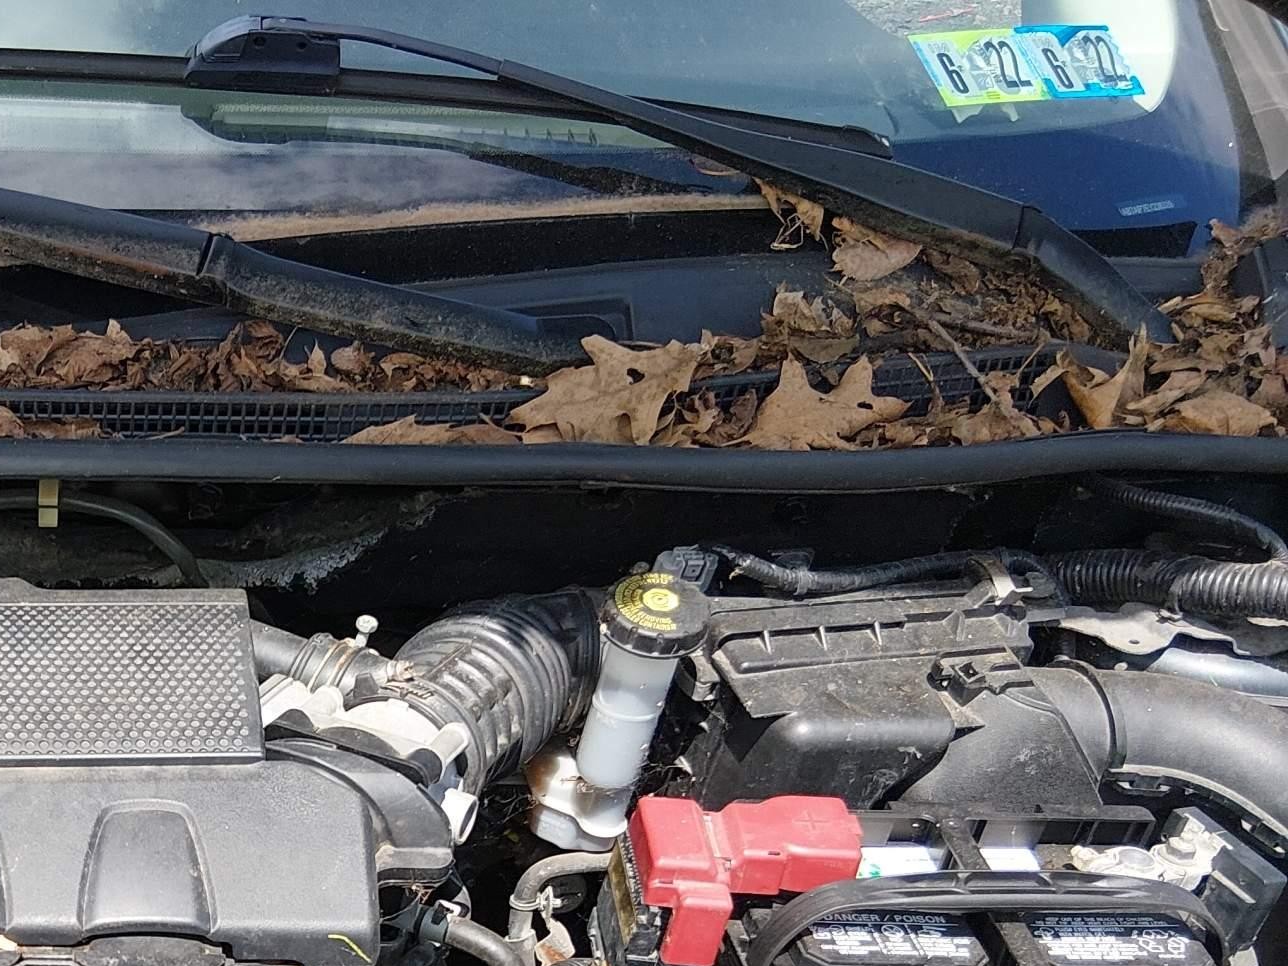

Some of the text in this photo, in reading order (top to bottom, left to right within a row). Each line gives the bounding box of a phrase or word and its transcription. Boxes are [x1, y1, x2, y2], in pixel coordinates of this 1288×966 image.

[937, 40, 1033, 94] 6 22
[1042, 35, 1129, 89] 6 22
[824, 912, 880, 923] DANGER
[894, 914, 946, 924] POISON
